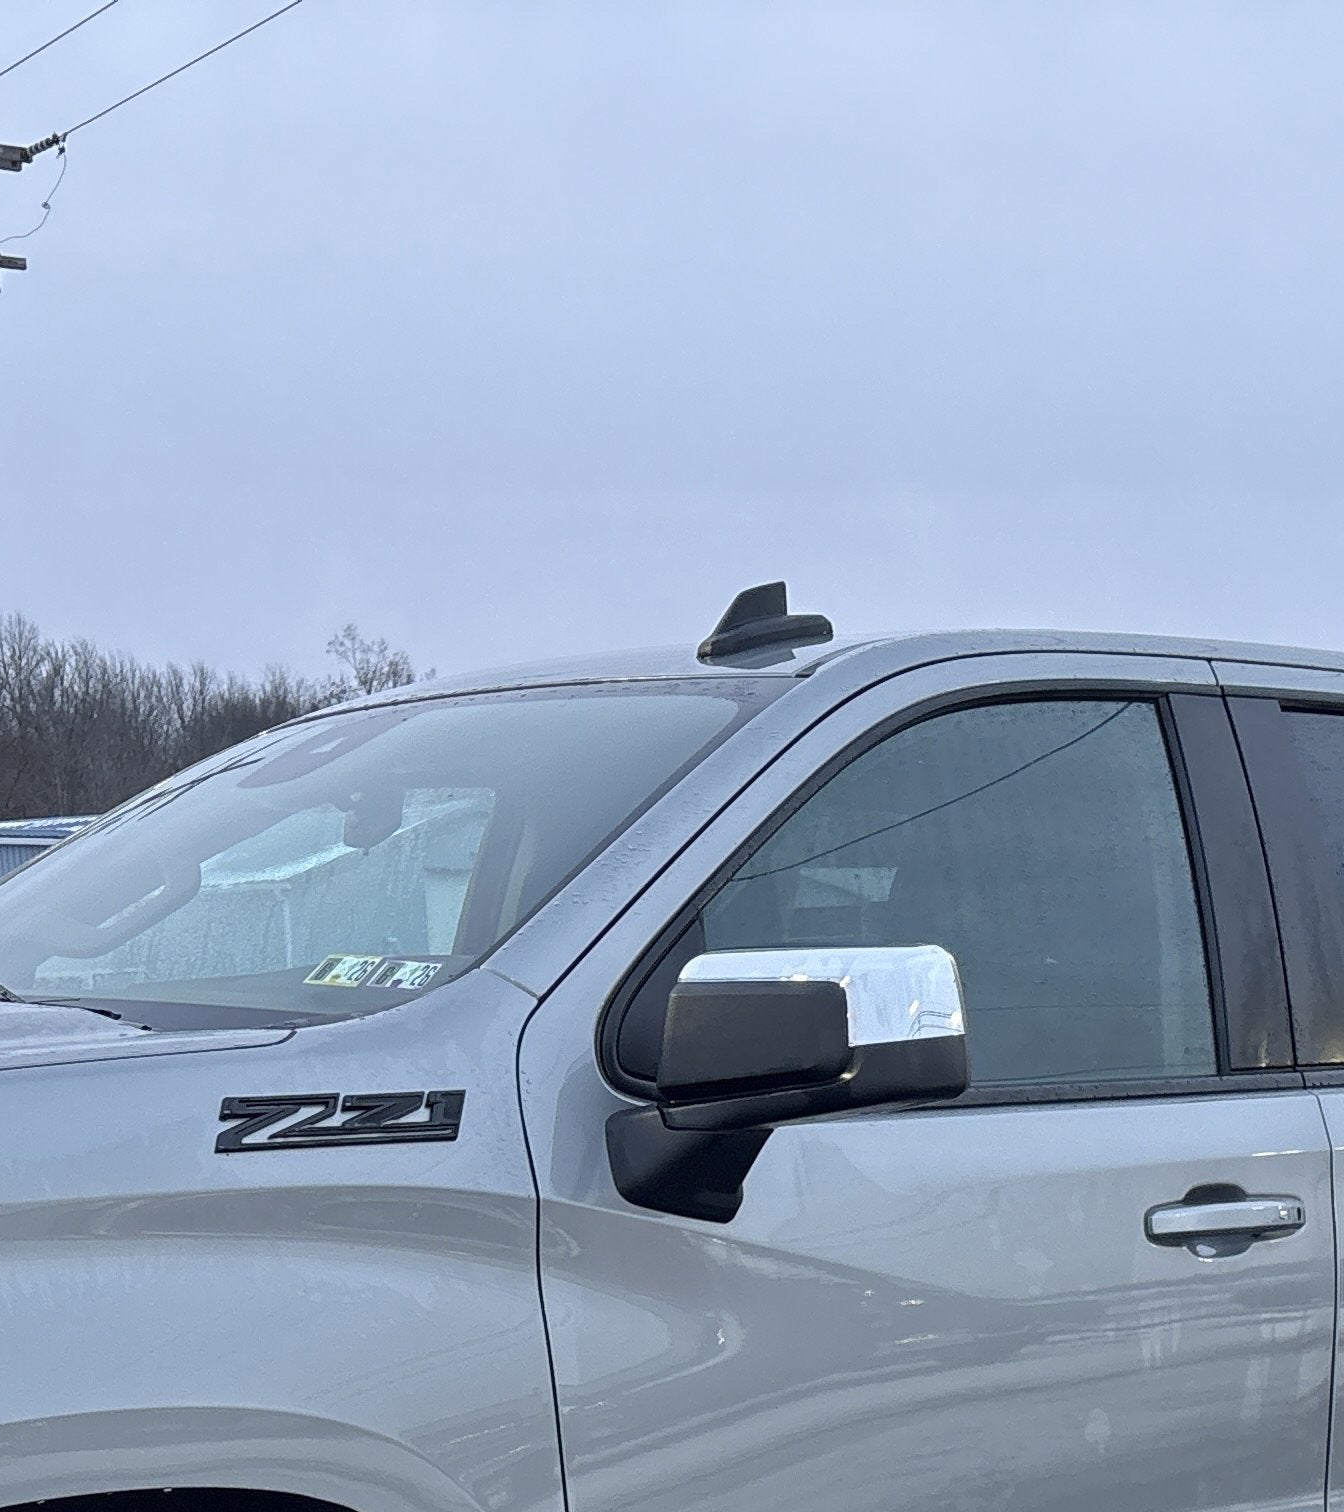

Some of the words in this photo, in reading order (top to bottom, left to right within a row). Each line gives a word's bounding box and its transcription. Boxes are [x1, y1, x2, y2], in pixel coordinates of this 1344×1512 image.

[346, 959, 377, 982] 26
[409, 964, 440, 987] 26
[214, 1088, 467, 1154] Z71
